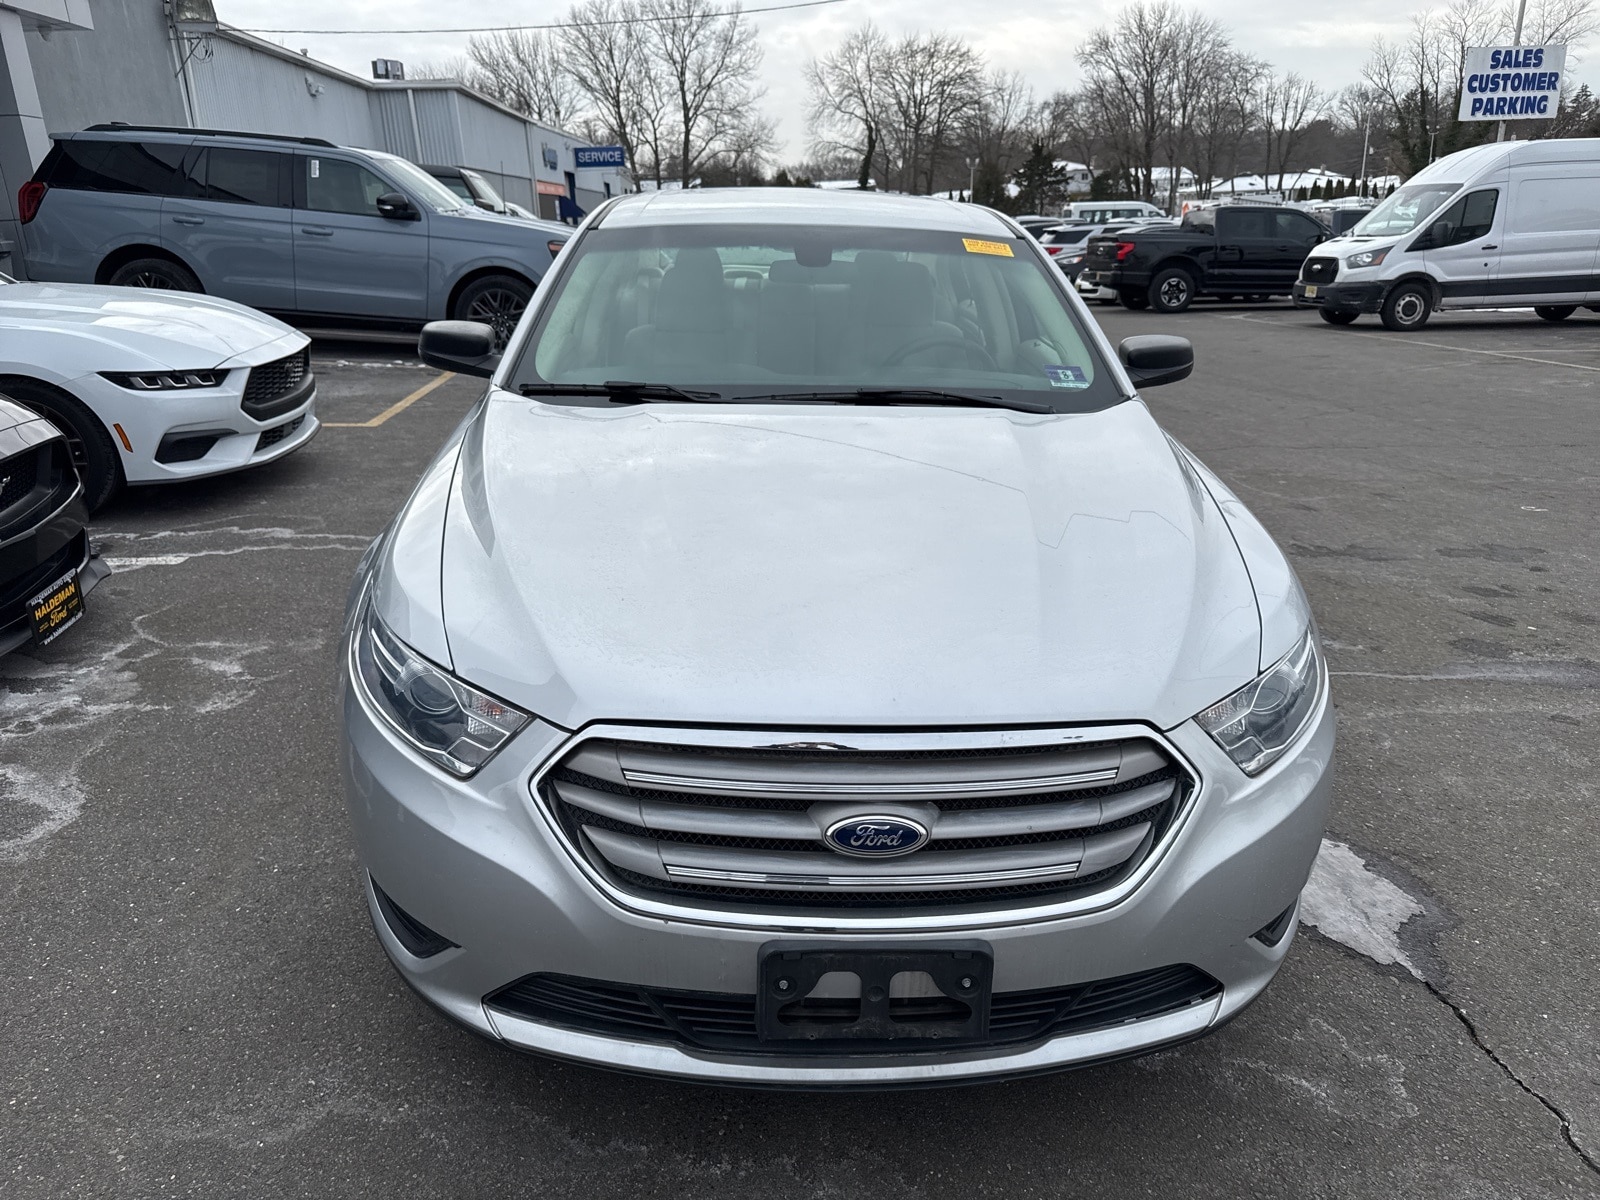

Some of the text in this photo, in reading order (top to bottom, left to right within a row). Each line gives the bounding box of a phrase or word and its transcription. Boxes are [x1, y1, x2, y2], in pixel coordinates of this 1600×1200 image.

[1490, 48, 1544, 70] SALES
[1467, 72, 1559, 93] CUSTOMER
[1470, 95, 1549, 116] PARKING
[577, 151, 622, 163] SERVICE
[34, 583, 76, 621] HALDEMAN
[49, 605, 68, 627] Ford
[850, 824, 904, 847] Ford
